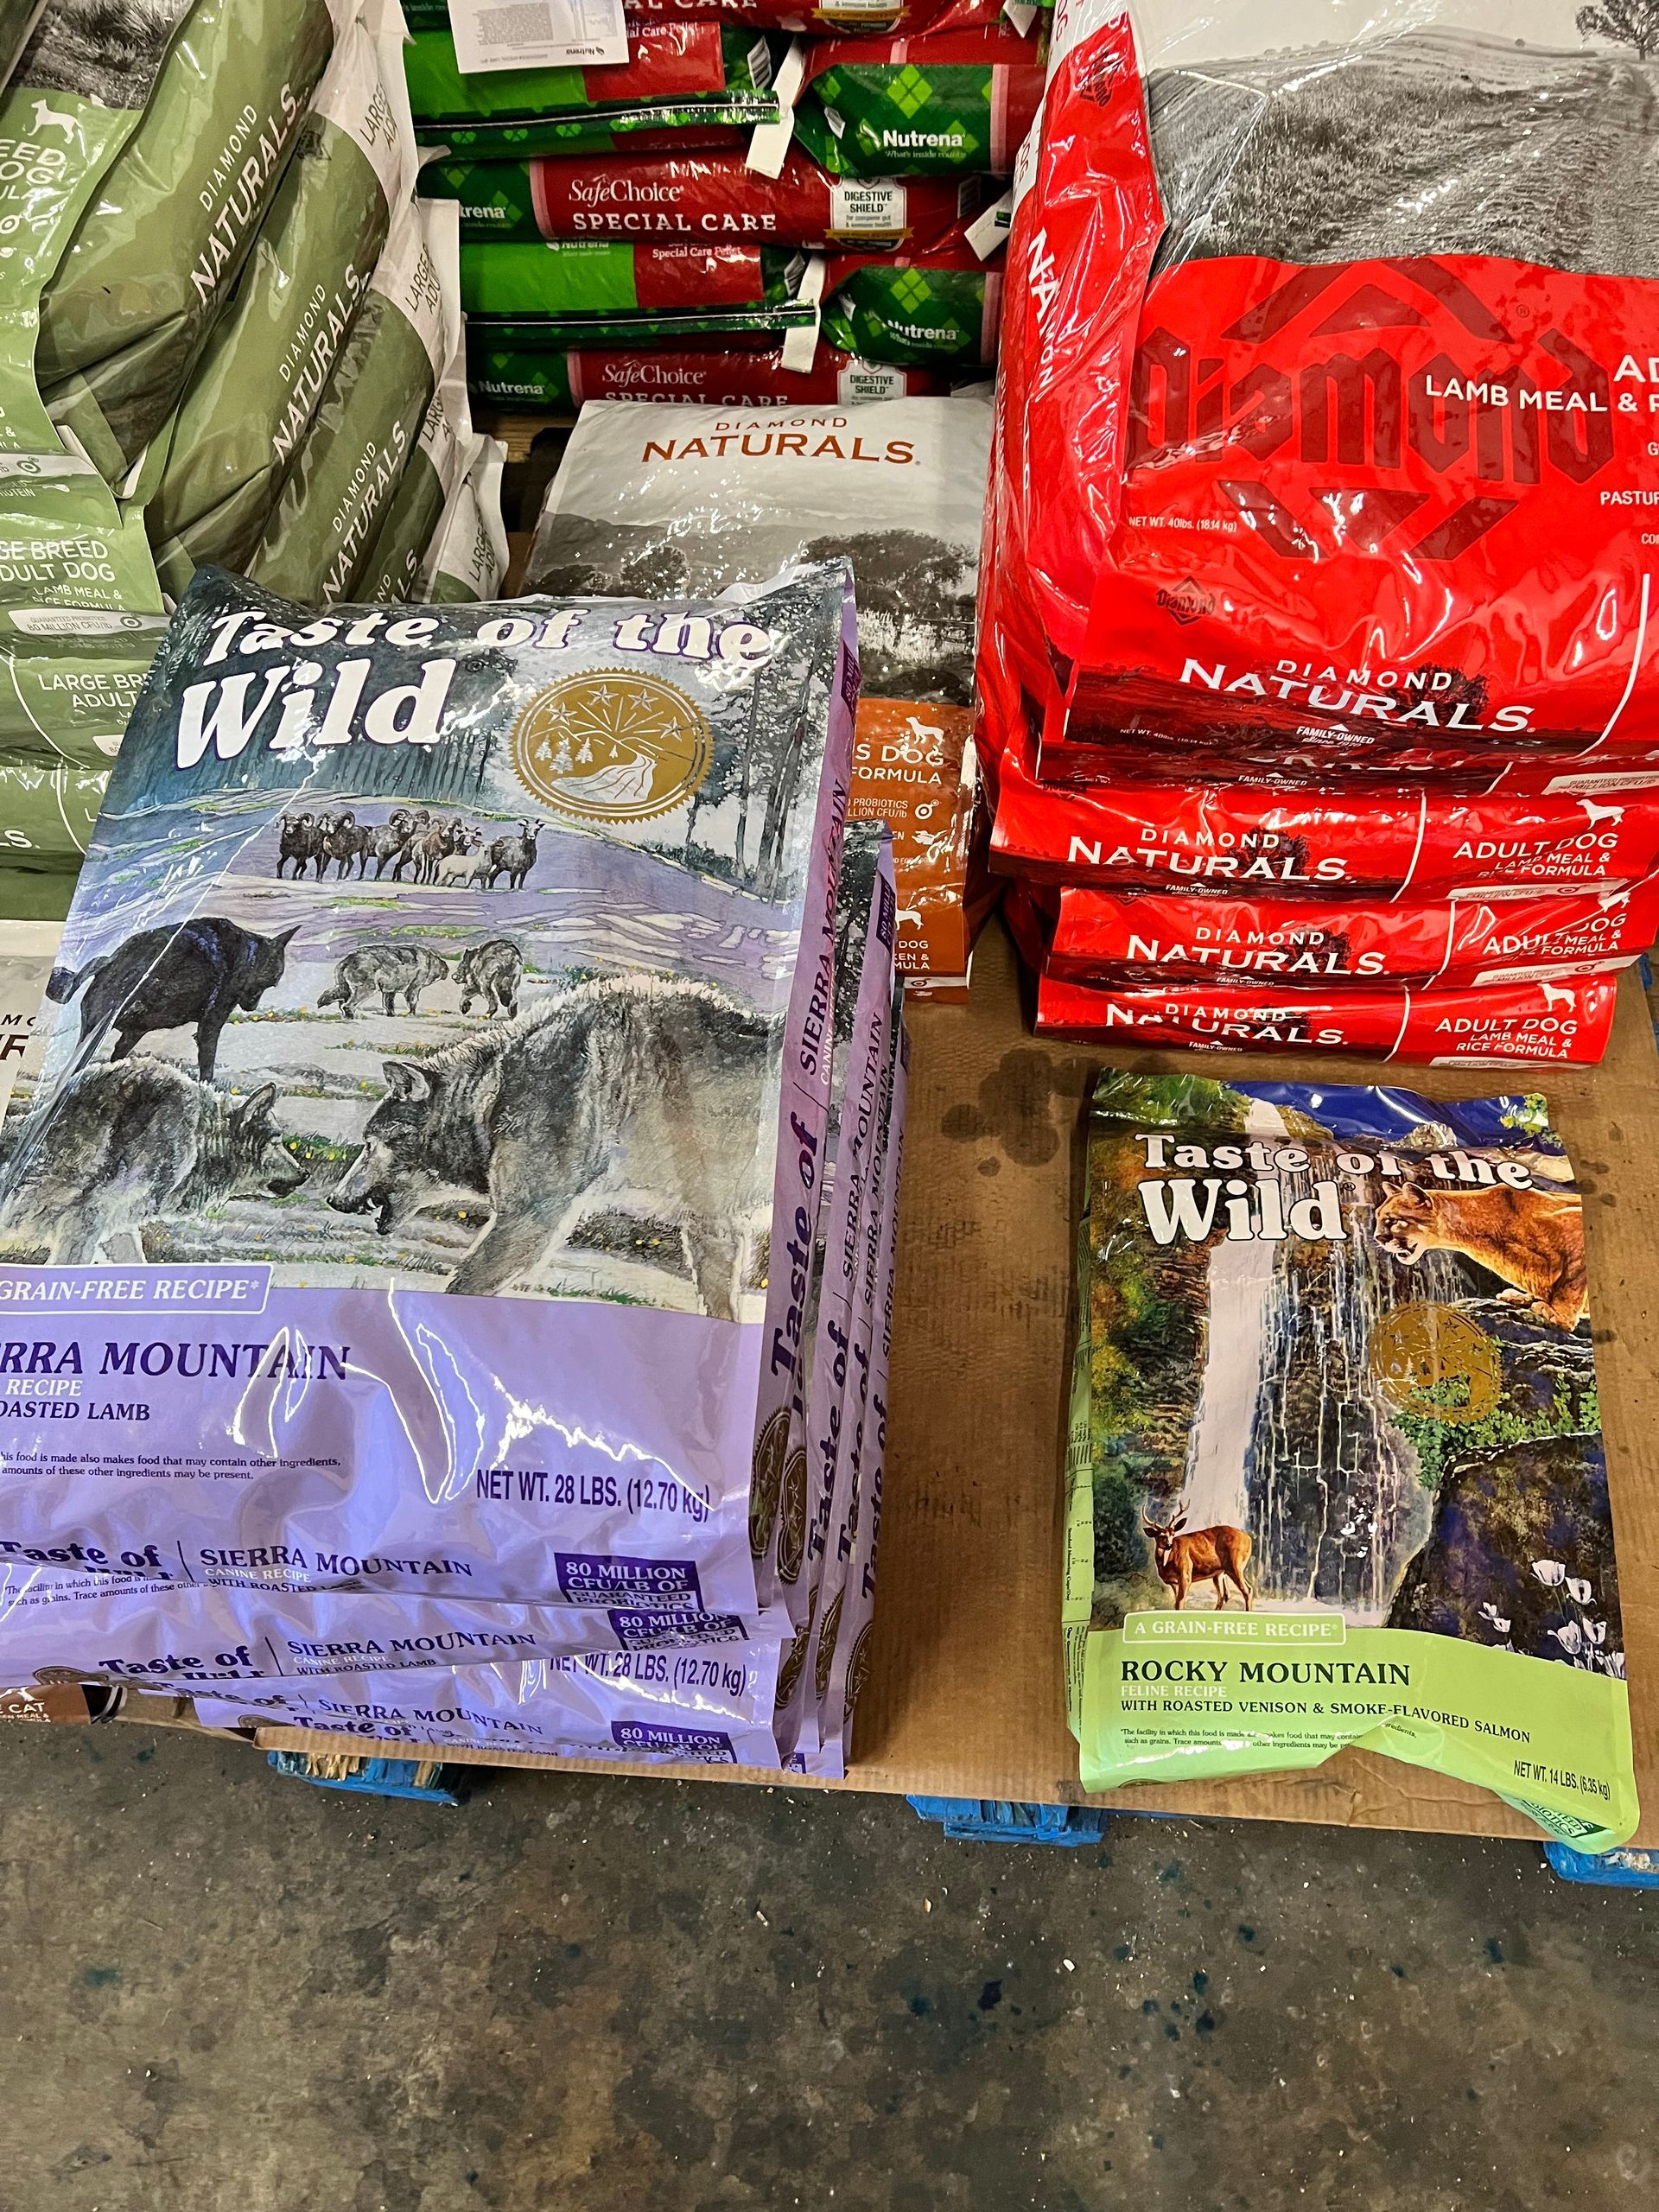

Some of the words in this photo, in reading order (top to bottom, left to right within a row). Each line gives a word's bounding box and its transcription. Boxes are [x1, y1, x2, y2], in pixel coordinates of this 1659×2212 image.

[883, 130, 965, 148] Nutrena
[198, 103, 258, 213] DIAMOND
[189, 82, 301, 305] NATURALS
[569, 180, 683, 207] SafeChoice
[844, 191, 893, 201] DIGESTIVE
[574, 213, 690, 230] SPECIAL
[701, 214, 776, 231] CARE
[279, 283, 327, 383] DIAMOND
[602, 364, 706, 387] SafeChoice
[850, 375, 894, 385] DIGESTIVE
[479, 380, 544, 395] Nutrena
[1426, 375, 1509, 406] LAMB
[1519, 389, 1608, 412] MEAL
[1618, 392, 1638, 412] &
[715, 417, 848, 431] DIAMOND
[642, 432, 921, 465] NATURALS
[332, 442, 377, 533] DIAMOND
[1128, 517, 1147, 527] NET
[1149, 517, 1165, 528] WT.
[1168, 518, 1194, 531] 40lbs.
[1222, 518, 1237, 533] kg)
[31, 540, 108, 560] BREED
[64, 562, 116, 582] DOG
[33, 586, 73, 596] LAMB
[75, 588, 110, 599] MEAL
[113, 589, 123, 600] &
[41, 622, 80, 632] MILLION
[203, 608, 434, 666] Taste
[477, 608, 588, 650] of
[613, 612, 772, 672] the
[38, 674, 111, 690] LARGE
[1276, 659, 1452, 691] DIAMOND
[73, 691, 137, 708] ADULT
[1179, 657, 1537, 734] NATURALS
[175, 658, 458, 771] Wild
[1296, 726, 1375, 745] FAMILY-OWNED
[881, 746, 944, 766] DOG
[852, 767, 942, 785] FORMULA
[1238, 774, 1307, 786] FAMILY-OWNED
[854, 798, 908, 810] PROBIOTICS
[1141, 828, 1280, 849] DIAMOND
[1452, 841, 1551, 859] ADULT
[1555, 832, 1619, 850] DOG
[1067, 836, 1353, 882] NATURALS
[1546, 852, 1593, 864] MEAL
[1599, 852, 1611, 863] &
[1520, 864, 1606, 877] FORMULA
[1166, 884, 1228, 896] FAMILY-OWNED
[899, 940, 928, 950] DOG
[1196, 926, 1325, 946] DIAMOND
[1126, 934, 1390, 976] NATURALS
[1216, 976, 1274, 987] FAMILY-OWNED
[800, 954, 831, 1076] SIERRA
[1165, 1002, 1287, 1023] DIAMOND
[1435, 1018, 1517, 1033] ADULT
[1522, 1017, 1578, 1034] DOG
[1189, 1041, 1243, 1053] FAMILY-OWNED
[1456, 1042, 1491, 1052] RICE
[1494, 1041, 1568, 1058] FORMULA
[1470, 1033, 1511, 1041] LAMB
[1516, 1033, 1558, 1046] MEAL
[1561, 1038, 1572, 1049] &
[852, 1011, 884, 1160] MOUNTAIN
[791, 1111, 818, 1190] of
[1135, 1133, 1311, 1173] Taste
[1431, 1150, 1535, 1190] the
[1137, 1179, 1350, 1244] Wild
[842, 1174, 860, 1282] SIERRA
[771, 1206, 811, 1376] Taste
[99, 1343, 351, 1381] MOUNTAIN
[827, 1320, 849, 1388] of
[6, 1379, 83, 1397] RECIPE
[87, 1403, 150, 1421] LAMB
[16, 1452, 37, 1461] food
[40, 1453, 48, 1462] is
[50, 1453, 78, 1463] made
[80, 1454, 100, 1464] also
[103, 1455, 135, 1465] makes
[137, 1455, 160, 1465] food
[162, 1456, 182, 1465] that
[185, 1459, 207, 1468] may
[209, 1457, 247, 1467] contain
[249, 1458, 276, 1467] other
[280, 1458, 341, 1470] ingredients,
[46, 1466, 56, 1475] of
[59, 1466, 86, 1476] these
[88, 1467, 113, 1477] other
[117, 1468, 171, 1480] ingredients
[175, 1471, 196, 1481] may
[198, 1470, 212, 1479] be
[213, 1471, 253, 1482] present.
[809, 1404, 841, 1560] Taste
[476, 1470, 513, 1499] NET
[518, 1471, 550, 1502] WT.
[555, 1475, 574, 1503] 28
[581, 1476, 621, 1506] LBS.
[627, 1478, 677, 1514] (12.70
[683, 1484, 710, 1523] kg)
[121, 1545, 162, 1567] of
[200, 1545, 308, 1569] SIERRA
[316, 1553, 474, 1577] MOUNTAIN
[205, 1568, 259, 1580] CANINE
[263, 1569, 312, 1583] RECIPE
[566, 1562, 591, 1576] 80
[598, 1564, 686, 1580] MILLION
[73, 1591, 98, 1600] Trace
[100, 1586, 138, 1597] amounts
[139, 1584, 149, 1593] of
[151, 1583, 175, 1592] these
[568, 1577, 650, 1592] CFU/LB
[658, 1580, 689, 1592] OF
[572, 1591, 691, 1601] GUARANTEED
[620, 1616, 643, 1628] 80
[648, 1612, 728, 1628] MILLION
[1135, 1622, 1147, 1634] A
[1152, 1620, 1259, 1636] GRAIN-FREE
[287, 1640, 385, 1658] SIERRA
[390, 1631, 537, 1652] MOUNTAIN
[99, 1654, 202, 1675] Taste
[214, 1644, 255, 1667] of
[585, 1653, 608, 1676] WT.
[613, 1651, 632, 1678] 28
[634, 1653, 669, 1682] LBS.
[674, 1657, 720, 1689] (12.70
[721, 1662, 747, 1698] kg)
[1121, 1660, 1228, 1681] ROCKY
[1239, 1662, 1410, 1686] MOUNTAIN
[1121, 1685, 1168, 1697] FELINE
[1174, 1685, 1227, 1697] RECIPE
[9, 1702, 45, 1714] CAT
[318, 1699, 405, 1719] SIERRA
[413, 1707, 543, 1735] MOUNTAIN
[1121, 1700, 1158, 1712] WITH
[1163, 1700, 1233, 1713] ROASTED
[1239, 1701, 1307, 1713] VENISON
[1313, 1703, 1324, 1714] &
[1331, 1702, 1469, 1728] SMOKE-FLAVORED
[1474, 1720, 1530, 1743] SALMON
[620, 1727, 643, 1741] 80
[647, 1729, 729, 1745] MILLION
[1514, 1760, 1531, 1779] NET
[1533, 1764, 1548, 1783] WT.
[1549, 1769, 1559, 1786] 14
[1560, 1771, 1579, 1789] LBS.
[1580, 1776, 1598, 1795] (6.35
[1599, 1779, 1611, 1801] kg)
